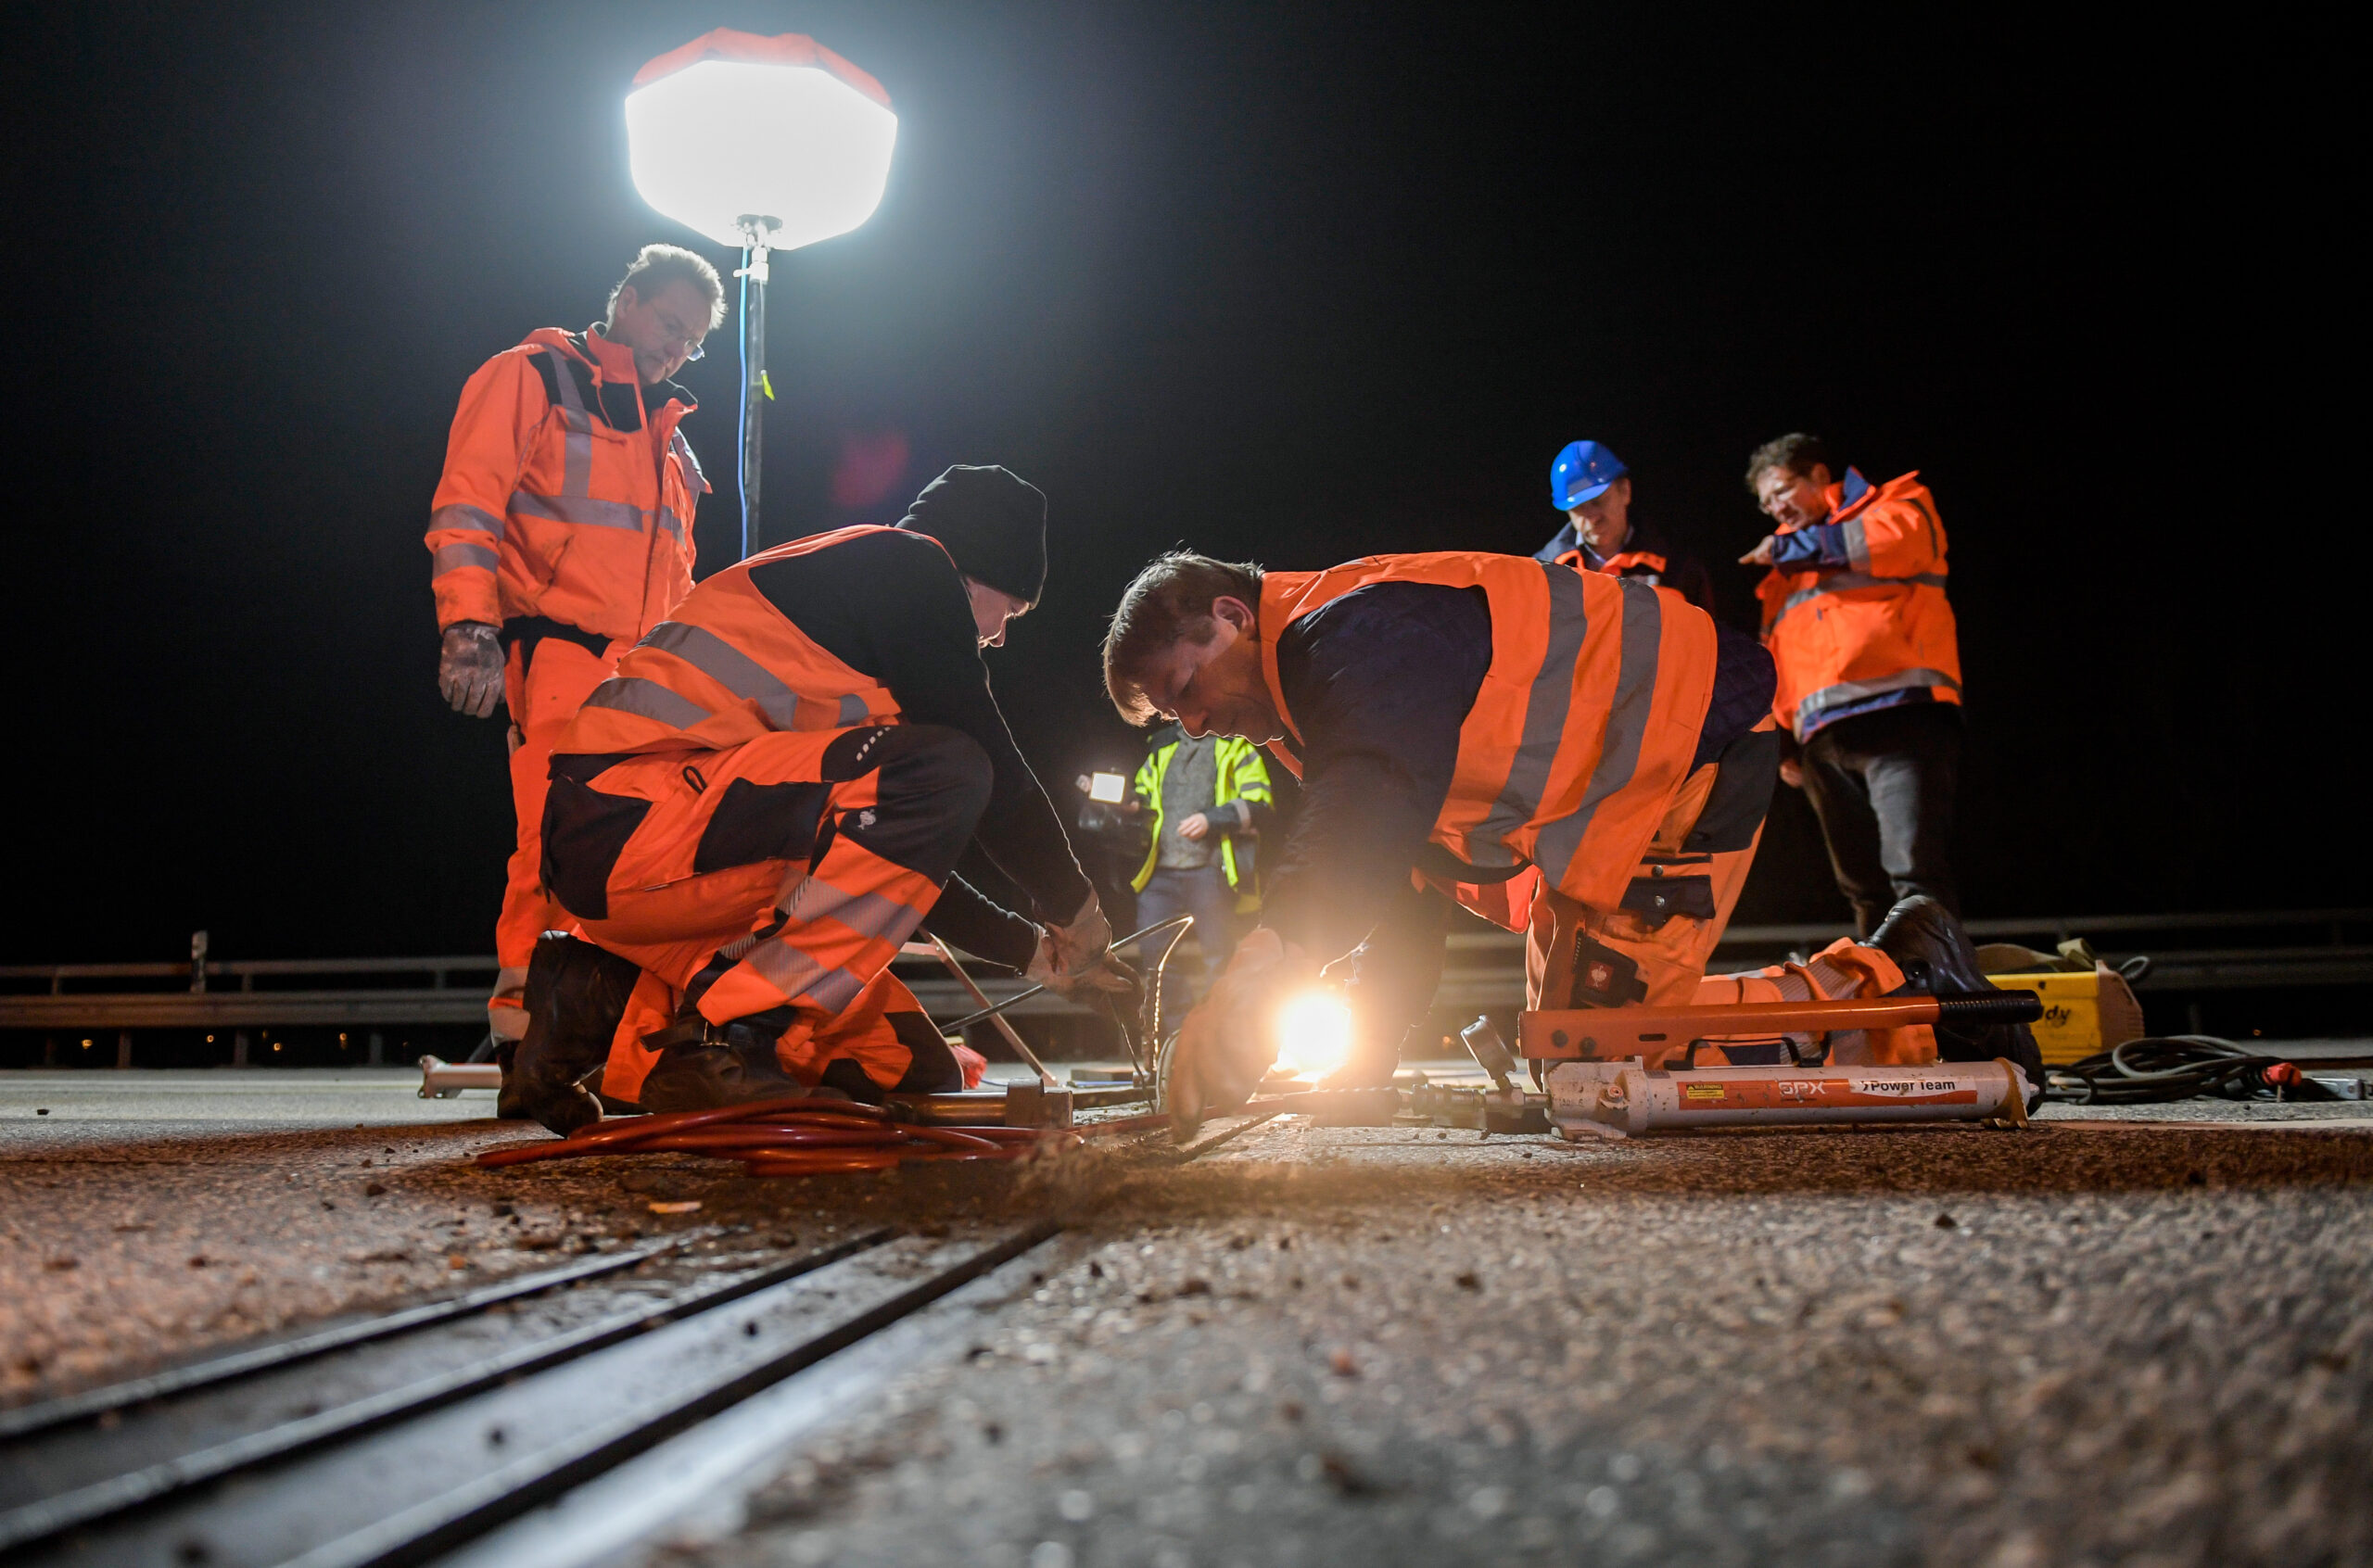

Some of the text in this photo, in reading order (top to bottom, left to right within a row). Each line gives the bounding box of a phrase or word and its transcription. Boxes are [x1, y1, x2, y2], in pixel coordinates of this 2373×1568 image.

[1778, 1081, 1826, 1095] SPX
[1871, 1079, 1956, 1092] Power Team
